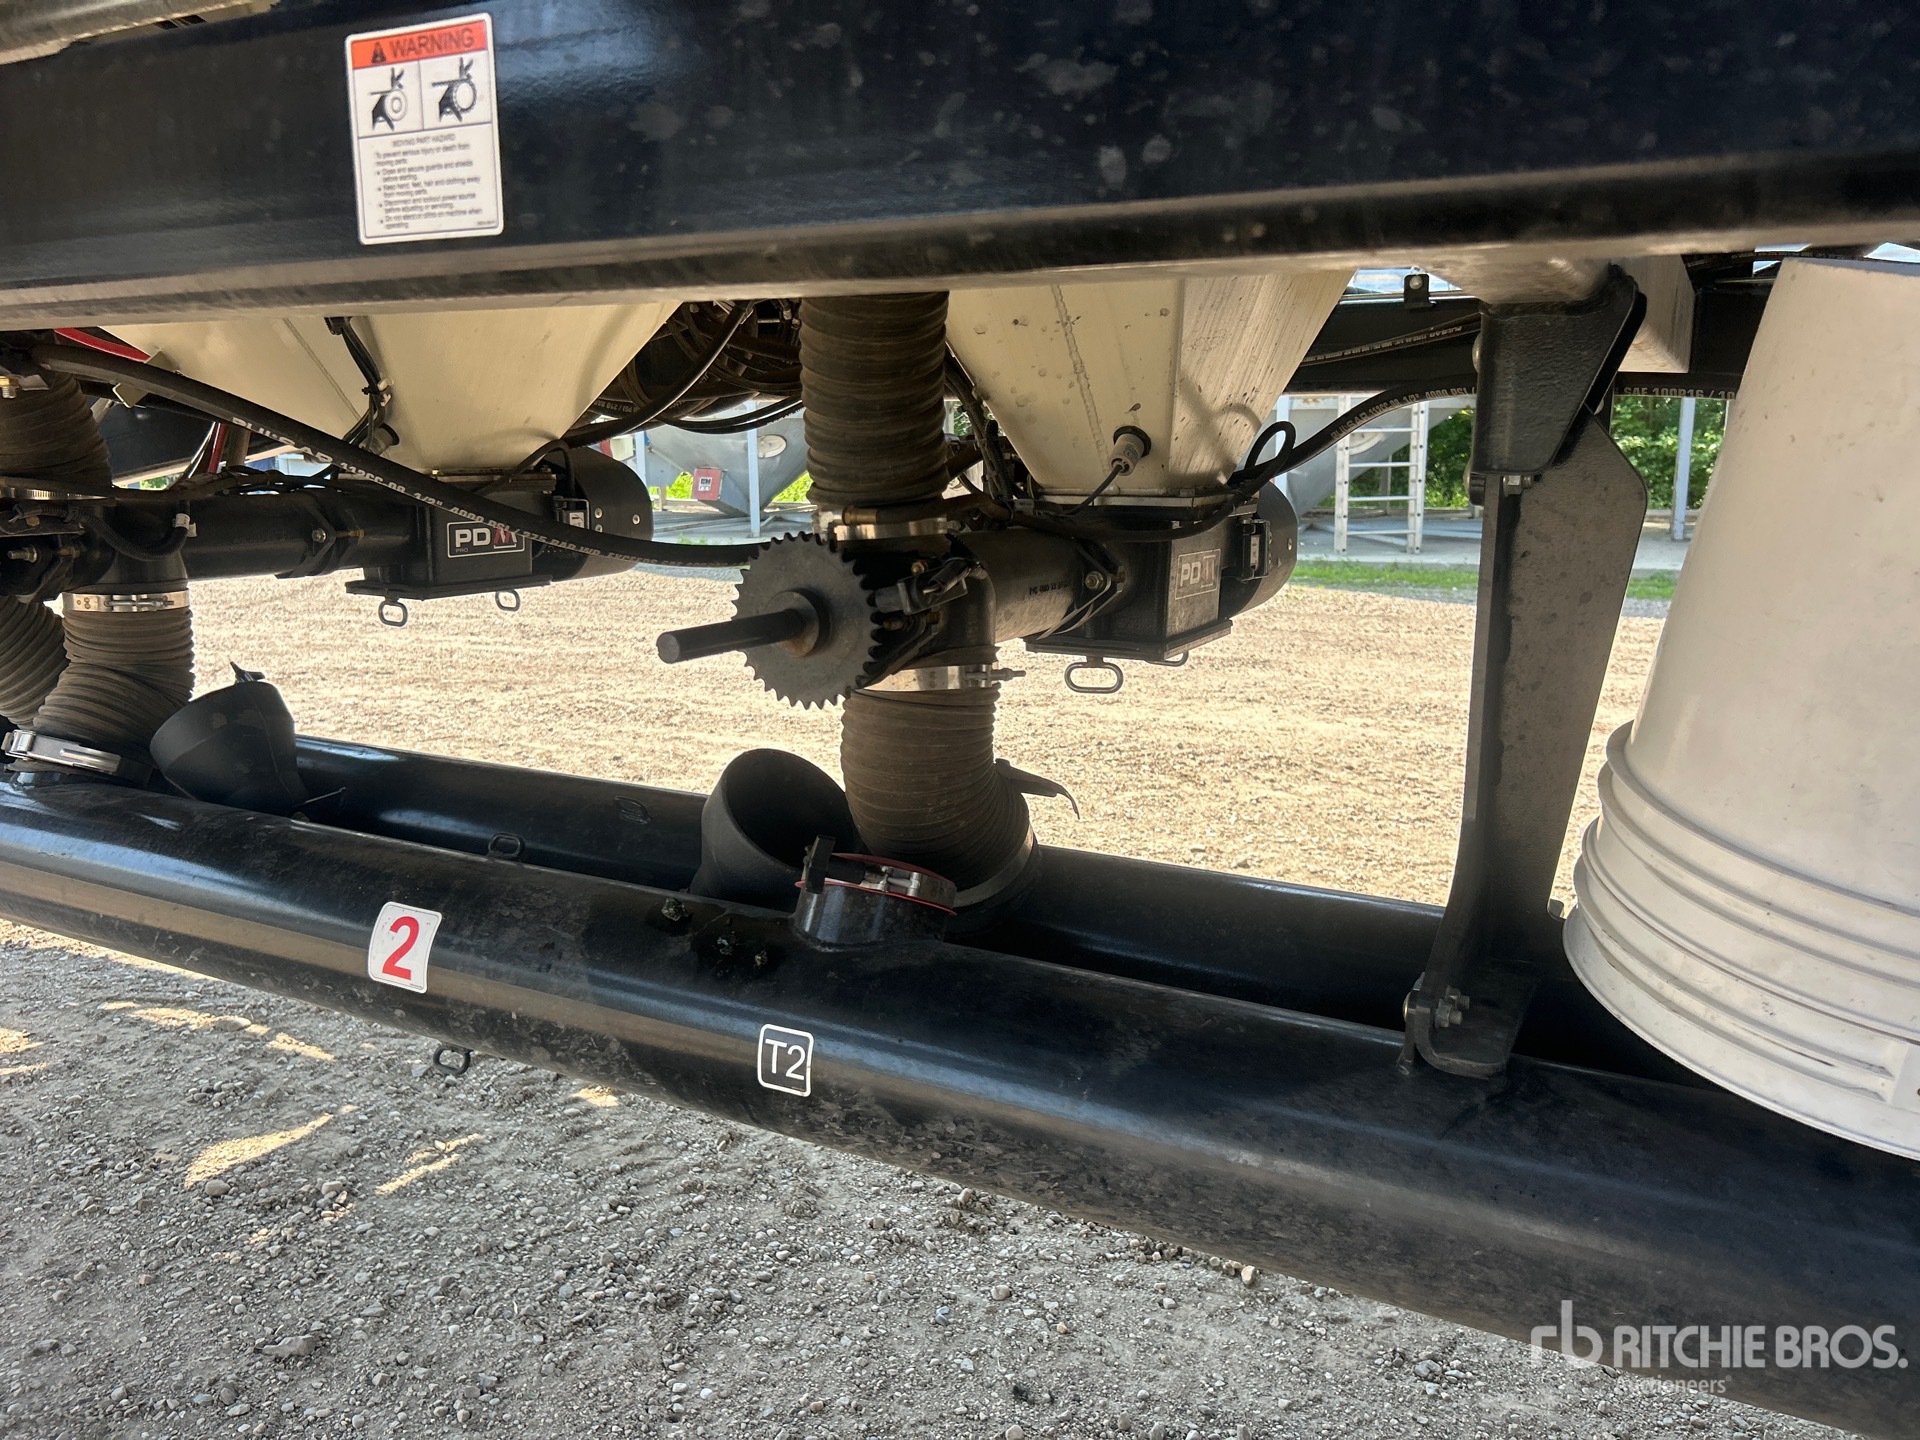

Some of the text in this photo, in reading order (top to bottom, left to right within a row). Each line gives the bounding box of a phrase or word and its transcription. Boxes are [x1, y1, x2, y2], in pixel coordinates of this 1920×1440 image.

[390, 28, 475, 58] WARNING
[382, 916, 420, 981] 2
[765, 1038, 806, 1081] T2
